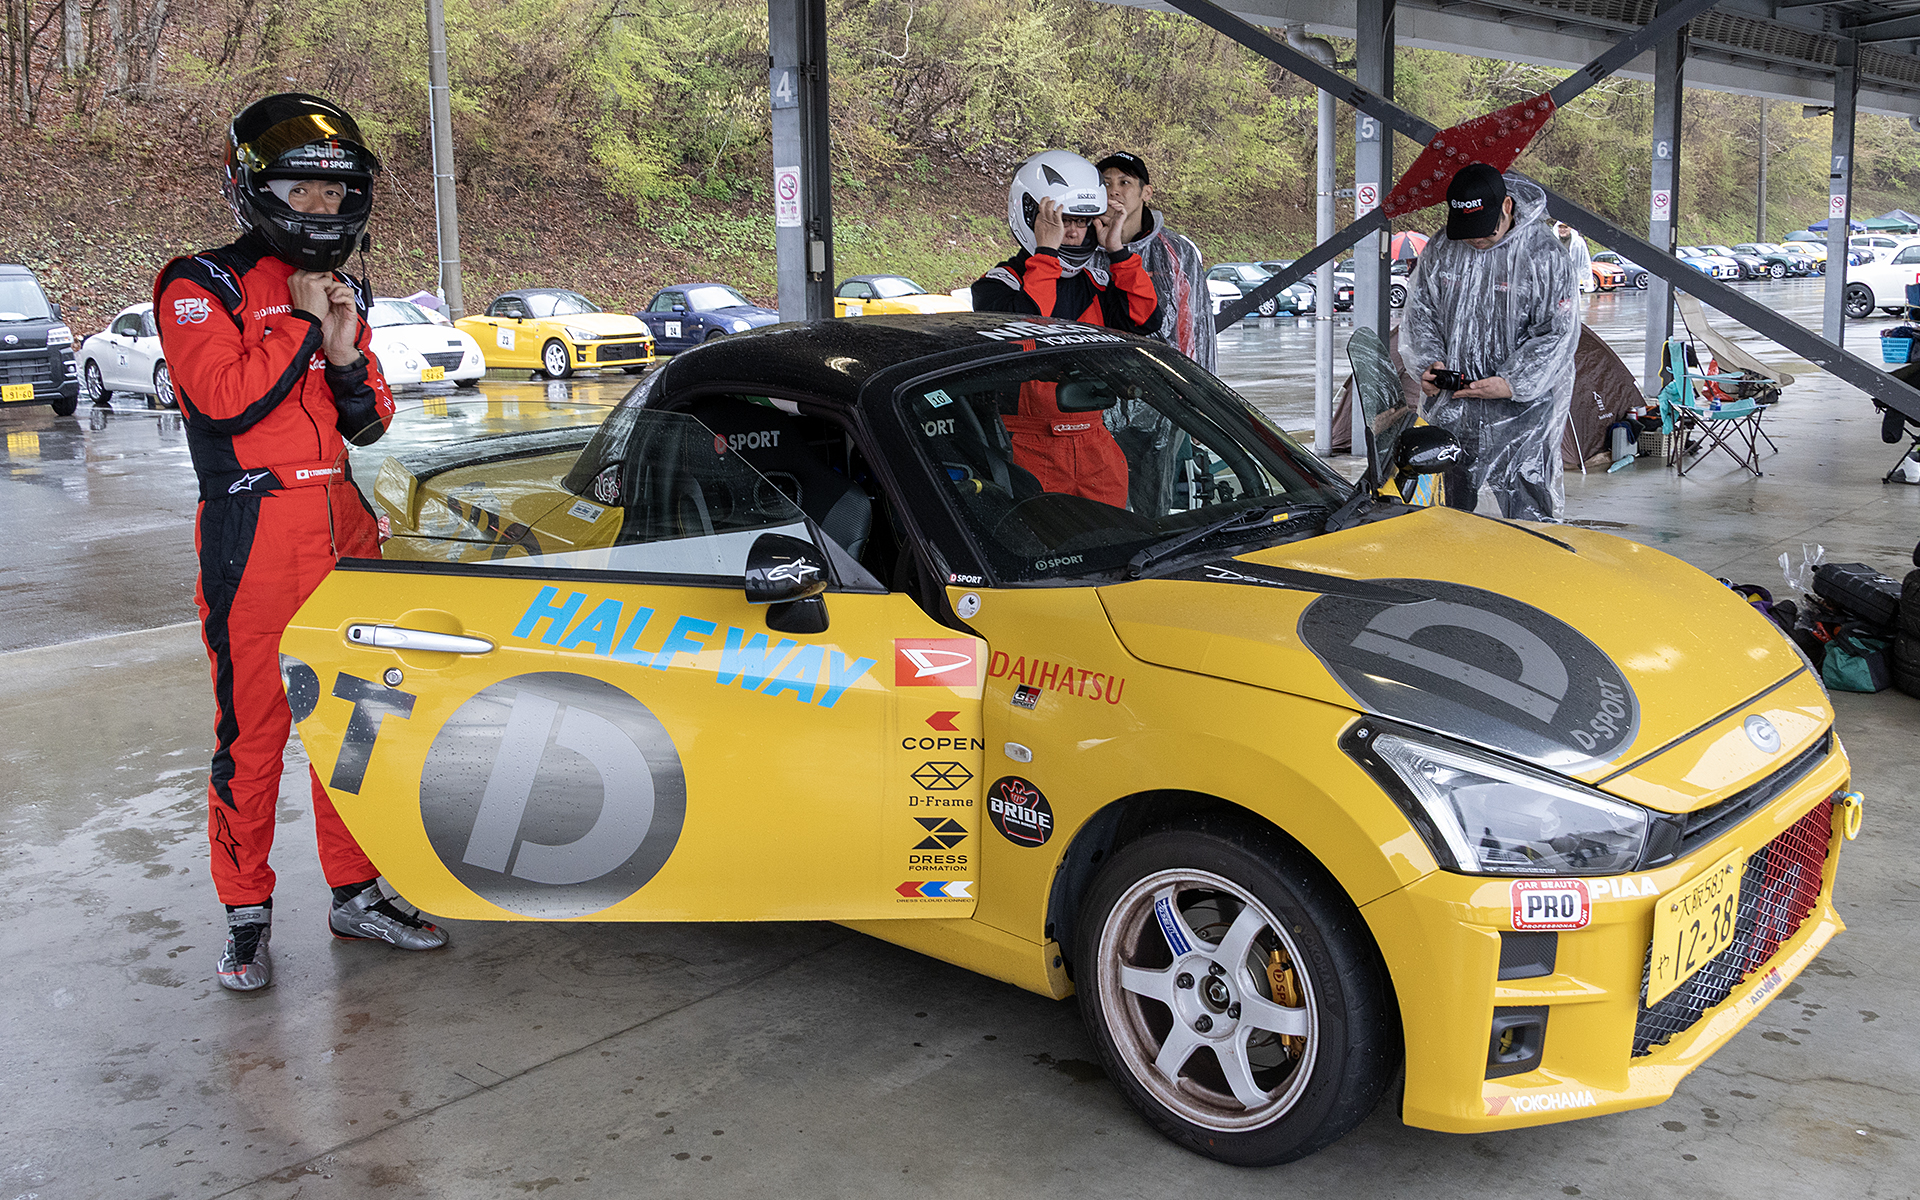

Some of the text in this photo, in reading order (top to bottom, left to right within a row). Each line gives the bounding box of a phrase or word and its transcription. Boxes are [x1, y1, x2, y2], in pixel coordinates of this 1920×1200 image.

[776, 71, 792, 102] 4
[1361, 117, 1375, 139] 5
[304, 141, 345, 159] Stilo
[1656, 141, 1668, 158] 6
[329, 160, 353, 170] SPORT
[1834, 155, 1845, 169] 7
[1457, 198, 1482, 209] SPORT
[174, 297, 213, 316] SPK
[932, 394, 945, 405] 10
[921, 418, 955, 438] ORT
[728, 430, 781, 451] SPORT
[1048, 554, 1084, 568] SPORT
[957, 573, 983, 585] SPORT
[988, 650, 1125, 705] DAIHATSU
[1012, 699, 1035, 709] SPORT
[1014, 690, 1038, 704] GR
[1569, 676, 1627, 751] D-SPORT
[901, 737, 985, 751] COPEN
[908, 796, 974, 807] D-Frame
[990, 796, 1051, 829] BRIDE
[909, 854, 968, 864] DRESS
[1516, 881, 1580, 890] CAR BEAUTY
[1588, 876, 1660, 900] PIAA
[1527, 894, 1574, 918] PRO
[1515, 910, 1523, 927] THE
[1579, 909, 1588, 926] WAY
[1656, 953, 1670, 980] や
[1673, 893, 1734, 981] 12-38
[1749, 967, 1782, 1005] ADVAN
[1510, 1090, 1597, 1113] YOKOHAMA
